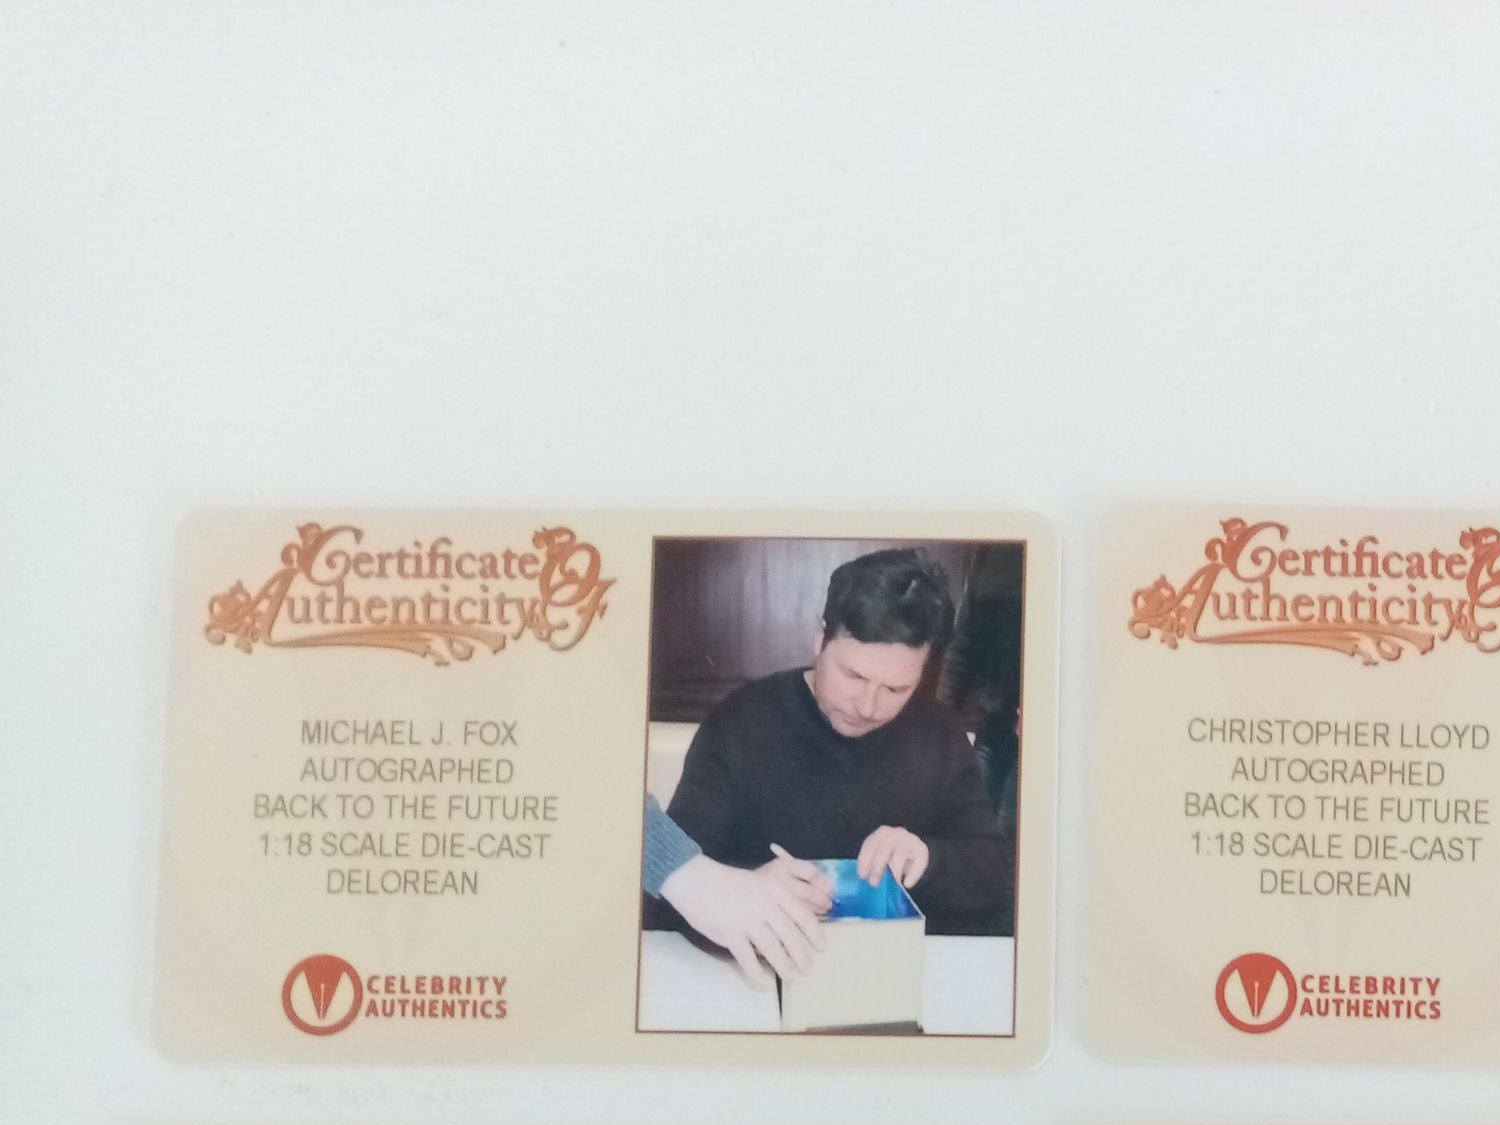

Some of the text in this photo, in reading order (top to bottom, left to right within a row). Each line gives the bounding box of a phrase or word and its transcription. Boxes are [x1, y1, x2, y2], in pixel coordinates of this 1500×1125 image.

[282, 522, 540, 586] Certificate
[1205, 518, 1468, 583] Certificate
[248, 569, 534, 647] Authenticity
[1173, 563, 1462, 643] Authenticity
[301, 719, 518, 747] MICHAEL J. FOX
[1187, 717, 1491, 751] CHRISTOPHER LLOYD
[300, 757, 515, 785] AUTOGRAPHED
[1230, 755, 1446, 787] AUTOGRAPHED
[253, 793, 558, 822] BACK TO THE FUTURE
[1184, 791, 1490, 825] BACK TO THE FUTURE
[260, 831, 552, 859] 1:18 SCALE DIE-CAST
[1191, 830, 1483, 863] 1:18 SCALE DIE-CAST
[326, 868, 479, 896] DELOREAN
[1259, 867, 1411, 898] DELOREAN
[365, 974, 508, 997] CELEBRITY
[1300, 973, 1442, 998] CELEBRITY
[365, 996, 508, 1021] AUTHENTICS
[1299, 996, 1442, 1021] AUTHENTICS
